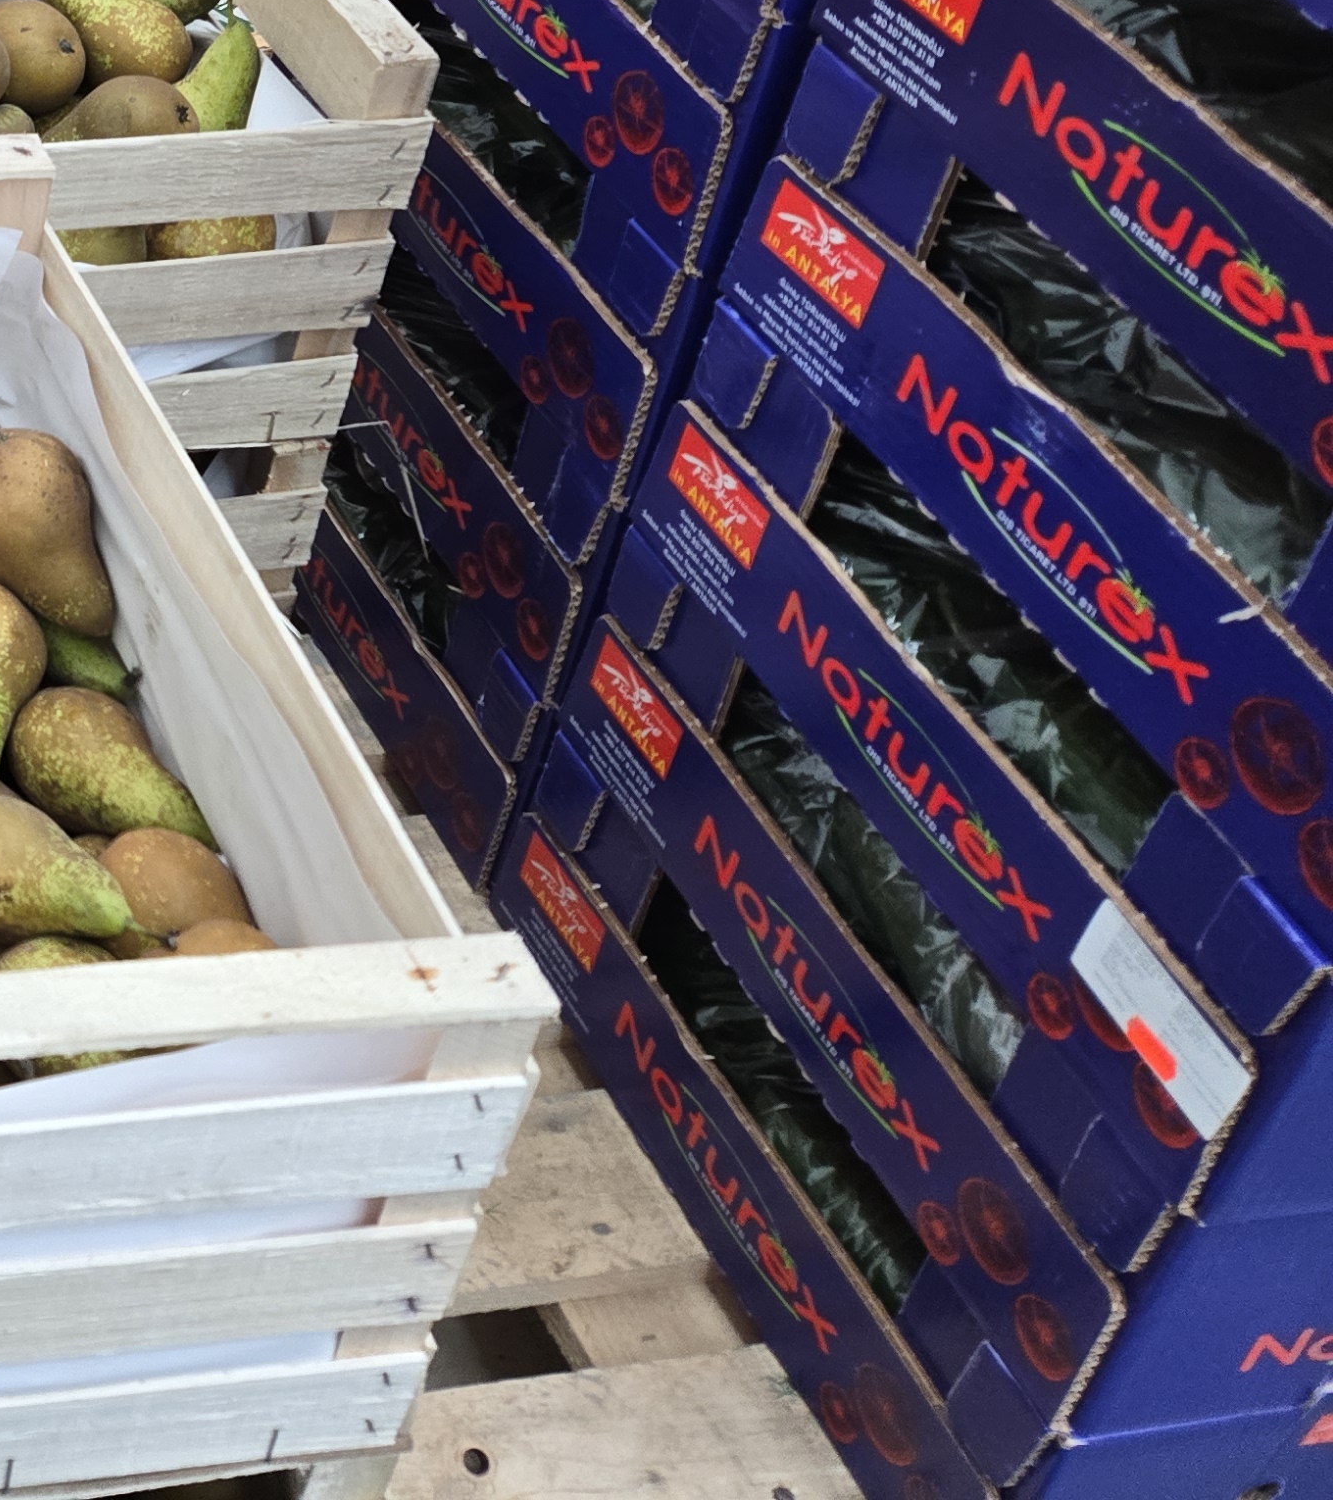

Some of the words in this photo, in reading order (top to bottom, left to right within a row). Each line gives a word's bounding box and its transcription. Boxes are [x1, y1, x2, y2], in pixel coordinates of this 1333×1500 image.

[415, 172, 534, 334] turex
[784, 245, 862, 326] ANTALYA
[998, 49, 1333, 382] Naturex
[352, 357, 473, 531] turex
[686, 484, 750, 566] ANTALYA
[896, 349, 1211, 704] Naturex
[300, 558, 410, 721] turex
[776, 589, 1052, 943] Naturex
[692, 813, 940, 1173] Naturex
[613, 1000, 837, 1356] Naturex
